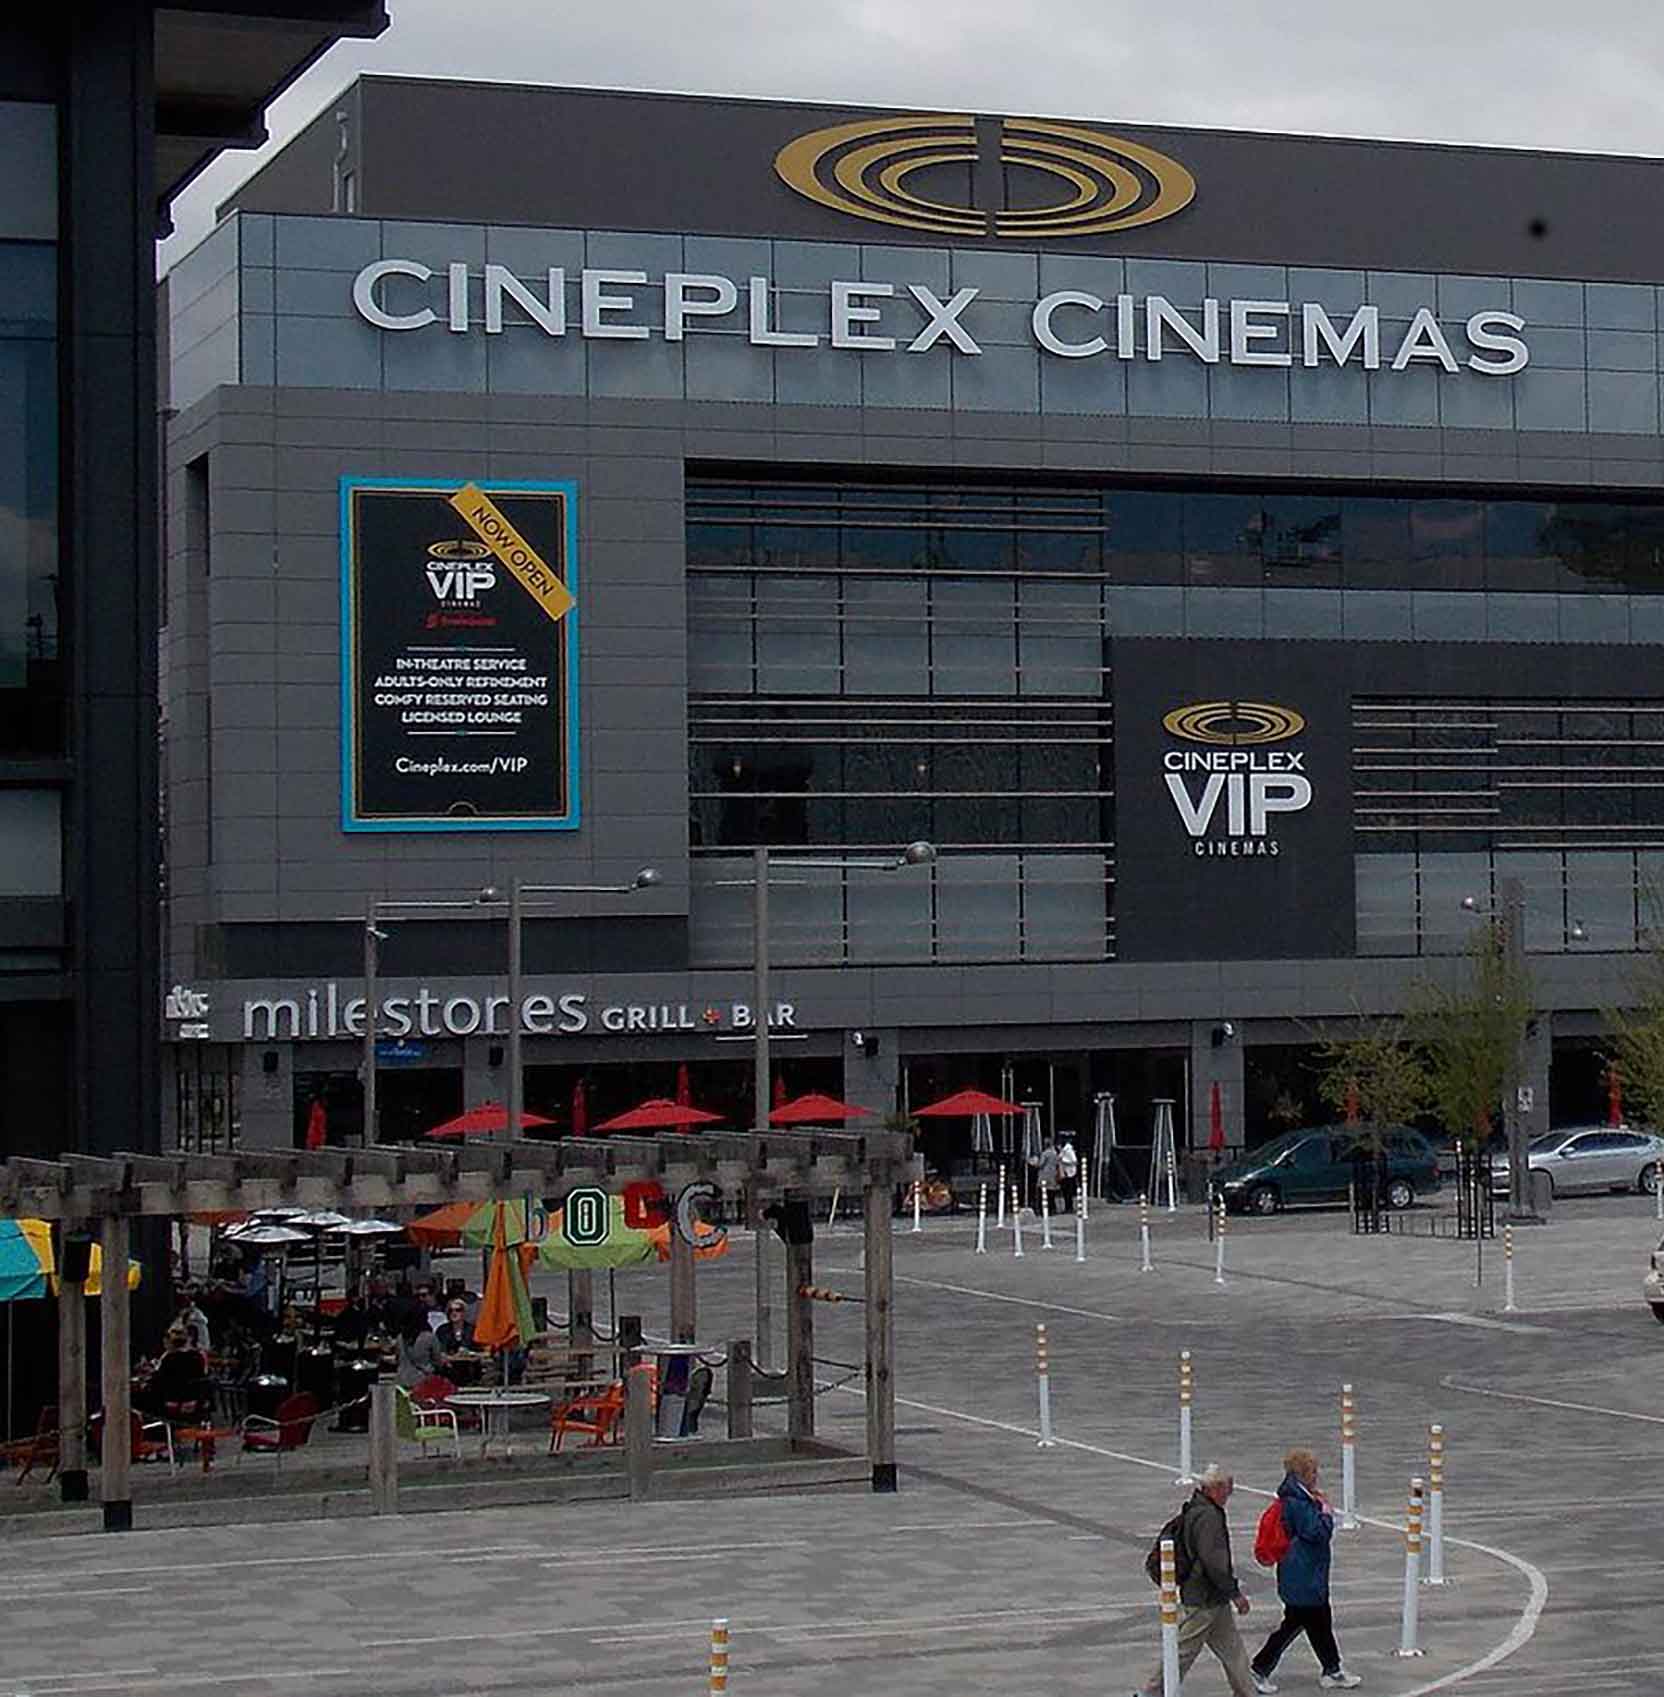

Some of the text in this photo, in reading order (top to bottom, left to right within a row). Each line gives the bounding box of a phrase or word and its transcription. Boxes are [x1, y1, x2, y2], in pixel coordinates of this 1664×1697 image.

[352, 258, 1530, 376] CINEPLEX CINEMAS
[471, 507, 555, 597] NOW OPEN
[426, 561, 495, 572] CINEPLEX
[425, 571, 497, 600] VIP
[396, 658, 527, 671] IN-THEATRE SERVICE
[374, 676, 464, 688] ADULTS-ONLY
[374, 694, 549, 706] COMFY RESERVED SEATING
[401, 711, 523, 724] LICENSED LOUNGE
[395, 757, 529, 776] Cineplex.com/VIP
[1163, 751, 1305, 771] CINEPLEX
[1163, 772, 1313, 837] VIP
[1194, 840, 1280, 856] CINEMAS
[243, 983, 589, 1038] milestones
[601, 1004, 696, 1031] GRILL
